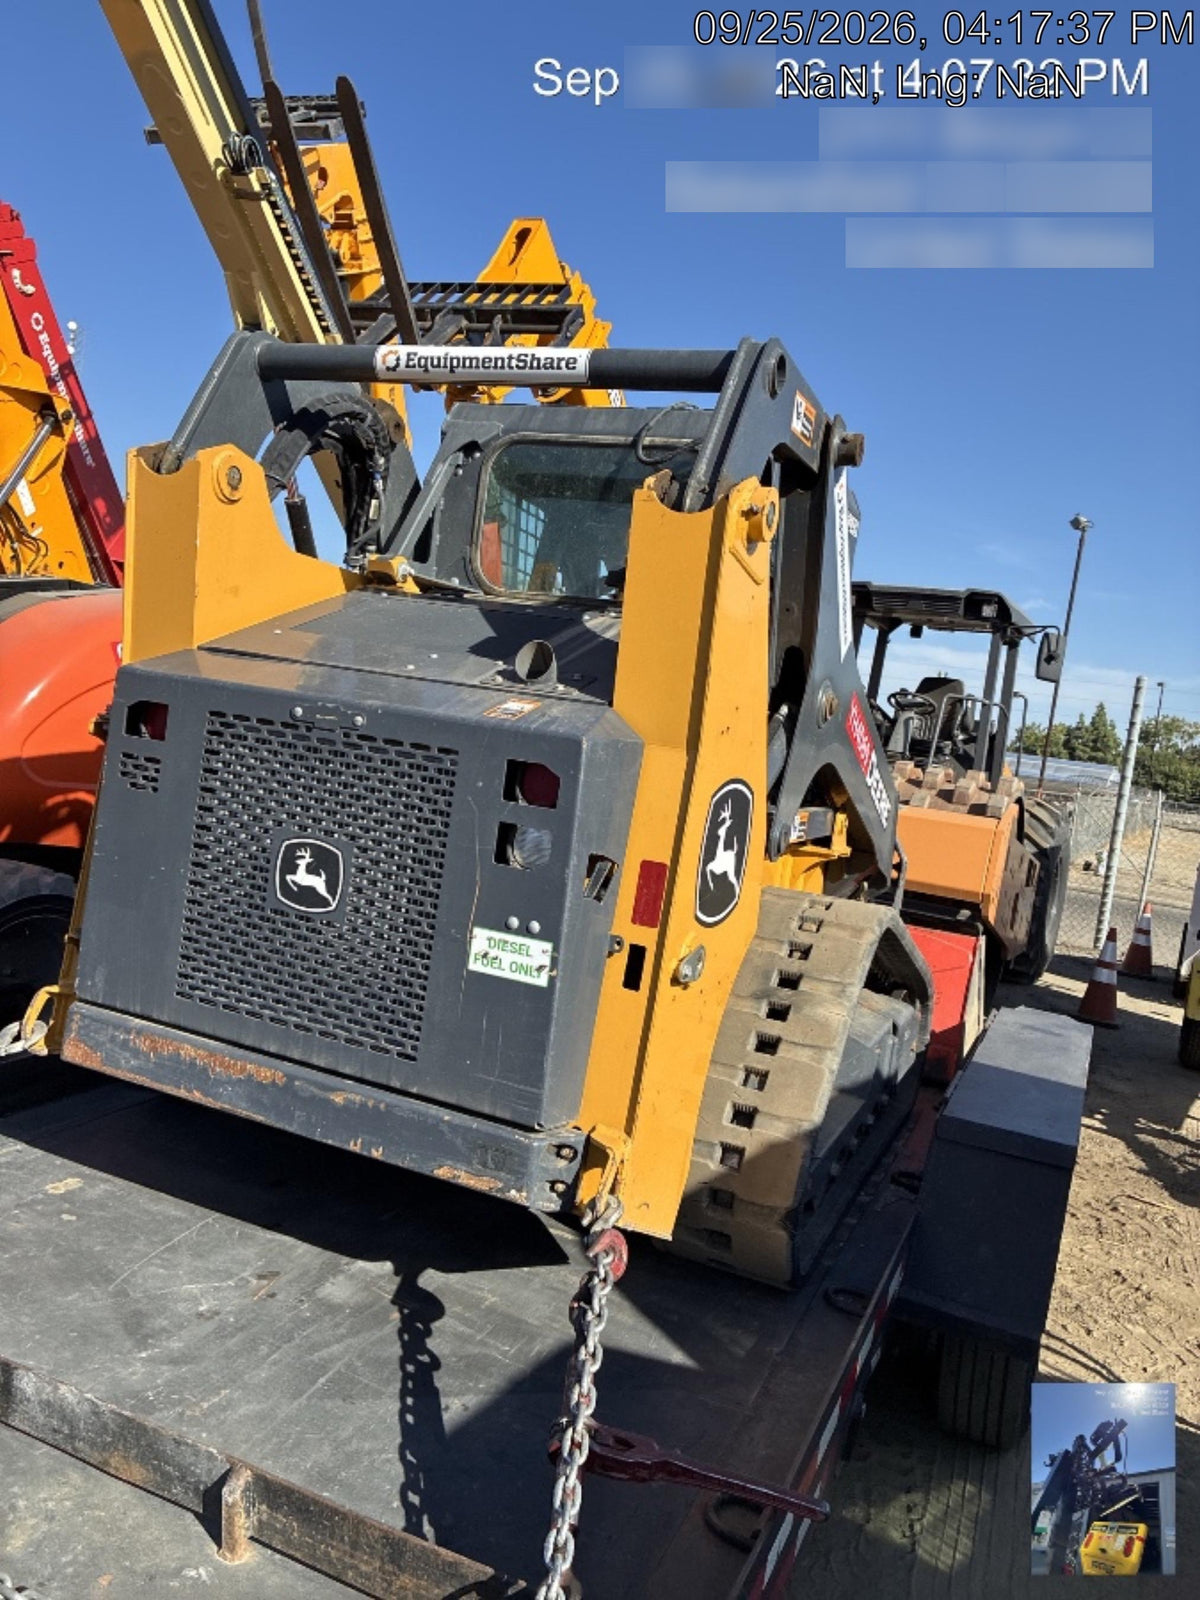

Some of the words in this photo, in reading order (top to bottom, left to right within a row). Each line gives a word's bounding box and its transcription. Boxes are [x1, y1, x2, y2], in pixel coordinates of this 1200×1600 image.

[404, 351, 578, 374] EquipmentShare
[486, 936, 534, 957] DIESEL
[473, 952, 506, 972] FUEL
[509, 961, 545, 979] ONLY
